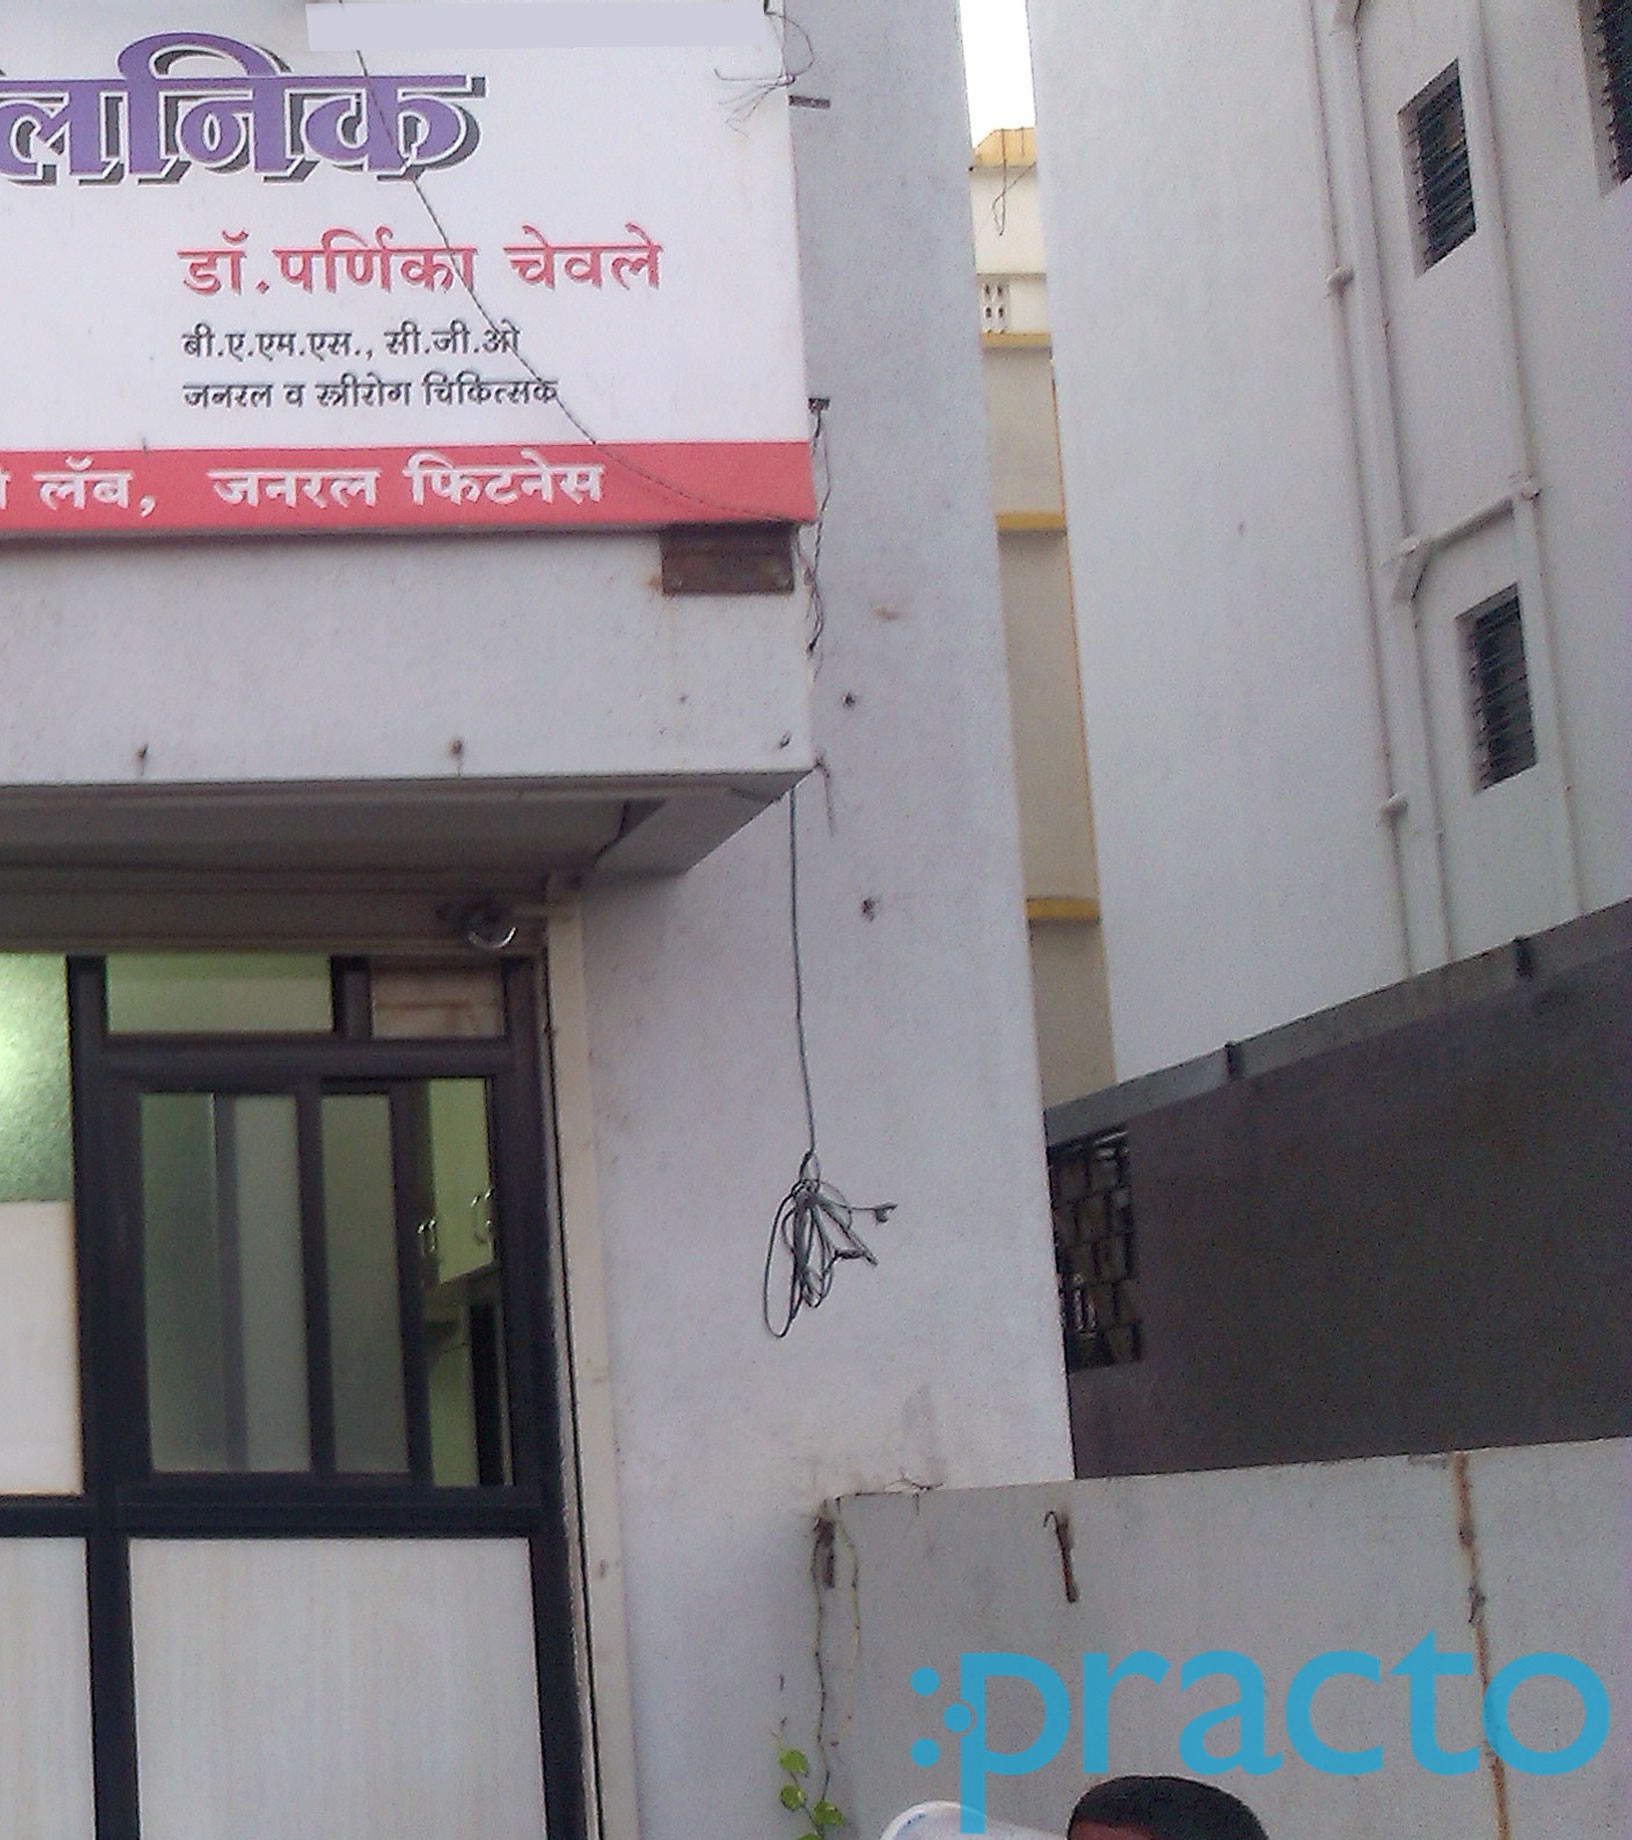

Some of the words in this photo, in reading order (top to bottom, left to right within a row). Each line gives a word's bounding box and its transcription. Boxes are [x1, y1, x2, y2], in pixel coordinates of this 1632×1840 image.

[176, 227, 479, 294] डॉ.पर्णिका
[502, 223, 662, 290] चेवले
[384, 318, 521, 357] सी.जी.ओ
[182, 383, 271, 410] जनरल
[283, 384, 305, 407] व
[314, 372, 412, 408] स्त्रीरोग
[422, 370, 560, 407] चिकित्सक
[32, 456, 157, 517] लॅब,
[208, 467, 380, 509] जनरल
[402, 450, 604, 505] फिटनेस
